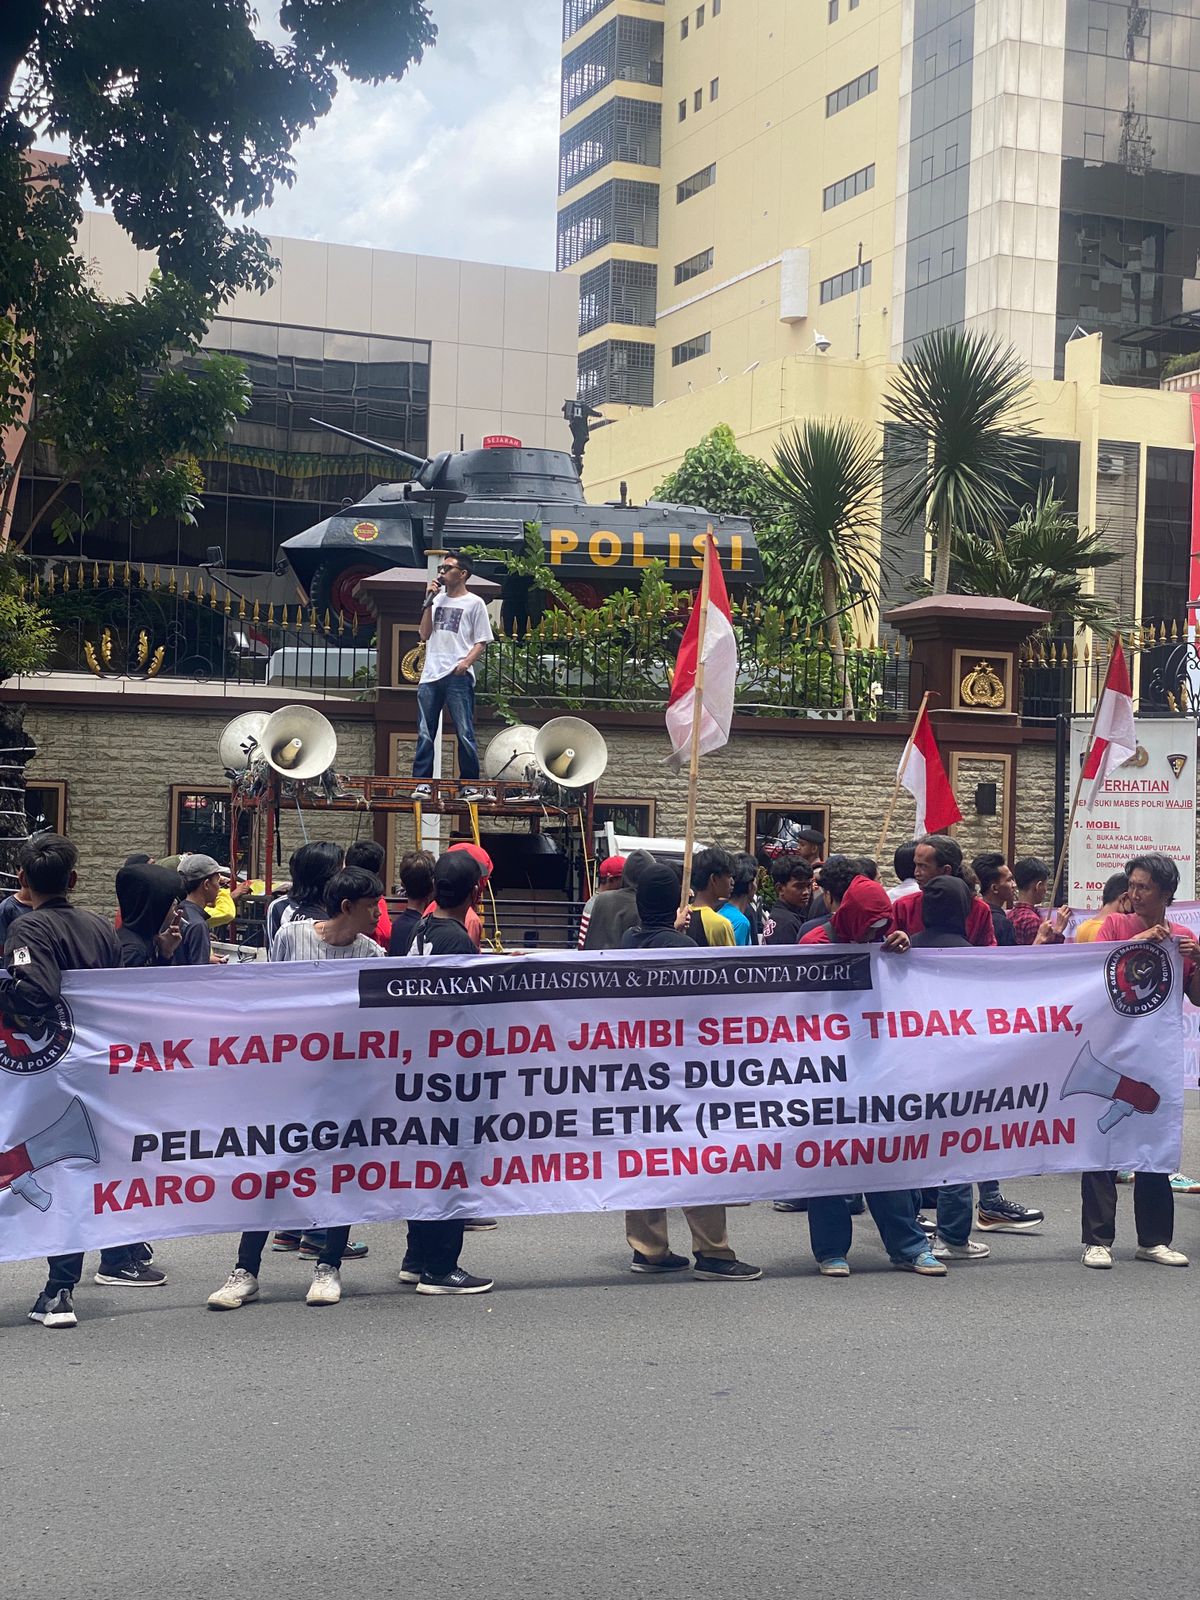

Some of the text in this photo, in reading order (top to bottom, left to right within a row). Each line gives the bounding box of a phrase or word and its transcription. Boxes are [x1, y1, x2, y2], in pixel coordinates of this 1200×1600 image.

[550, 529, 742, 570] POLISI
[1102, 780, 1170, 792] ERHATIAN
[1114, 799, 1139, 807] MABES
[1141, 800, 1164, 808] POLRI
[1165, 799, 1193, 808] WAJIB
[1074, 821, 1120, 829] 1. MOBIL
[1073, 881, 1083, 889] 2.
[386, 965, 851, 997] GERAKAN MAHASISWA & PEMUDA CINTA POLRI
[54, 1003, 68, 1031] EMUDA
[1134, 993, 1162, 1013] POLRI
[109, 1004, 1083, 1074] PAK KAPOLRI, POLDA JAMBI SEDANG TIDAK BAIK,
[27, 1045, 60, 1069] POLRI
[396, 1054, 847, 1103] USUT TUNTAS DUGAAN
[131, 1082, 1050, 1162] PELANGGARAN KODE ETIK (PERSELINGKUHAN)
[93, 1117, 1076, 1215] KARO OPS POLDA JAMBI DENGAN OKNUM POLWAN
